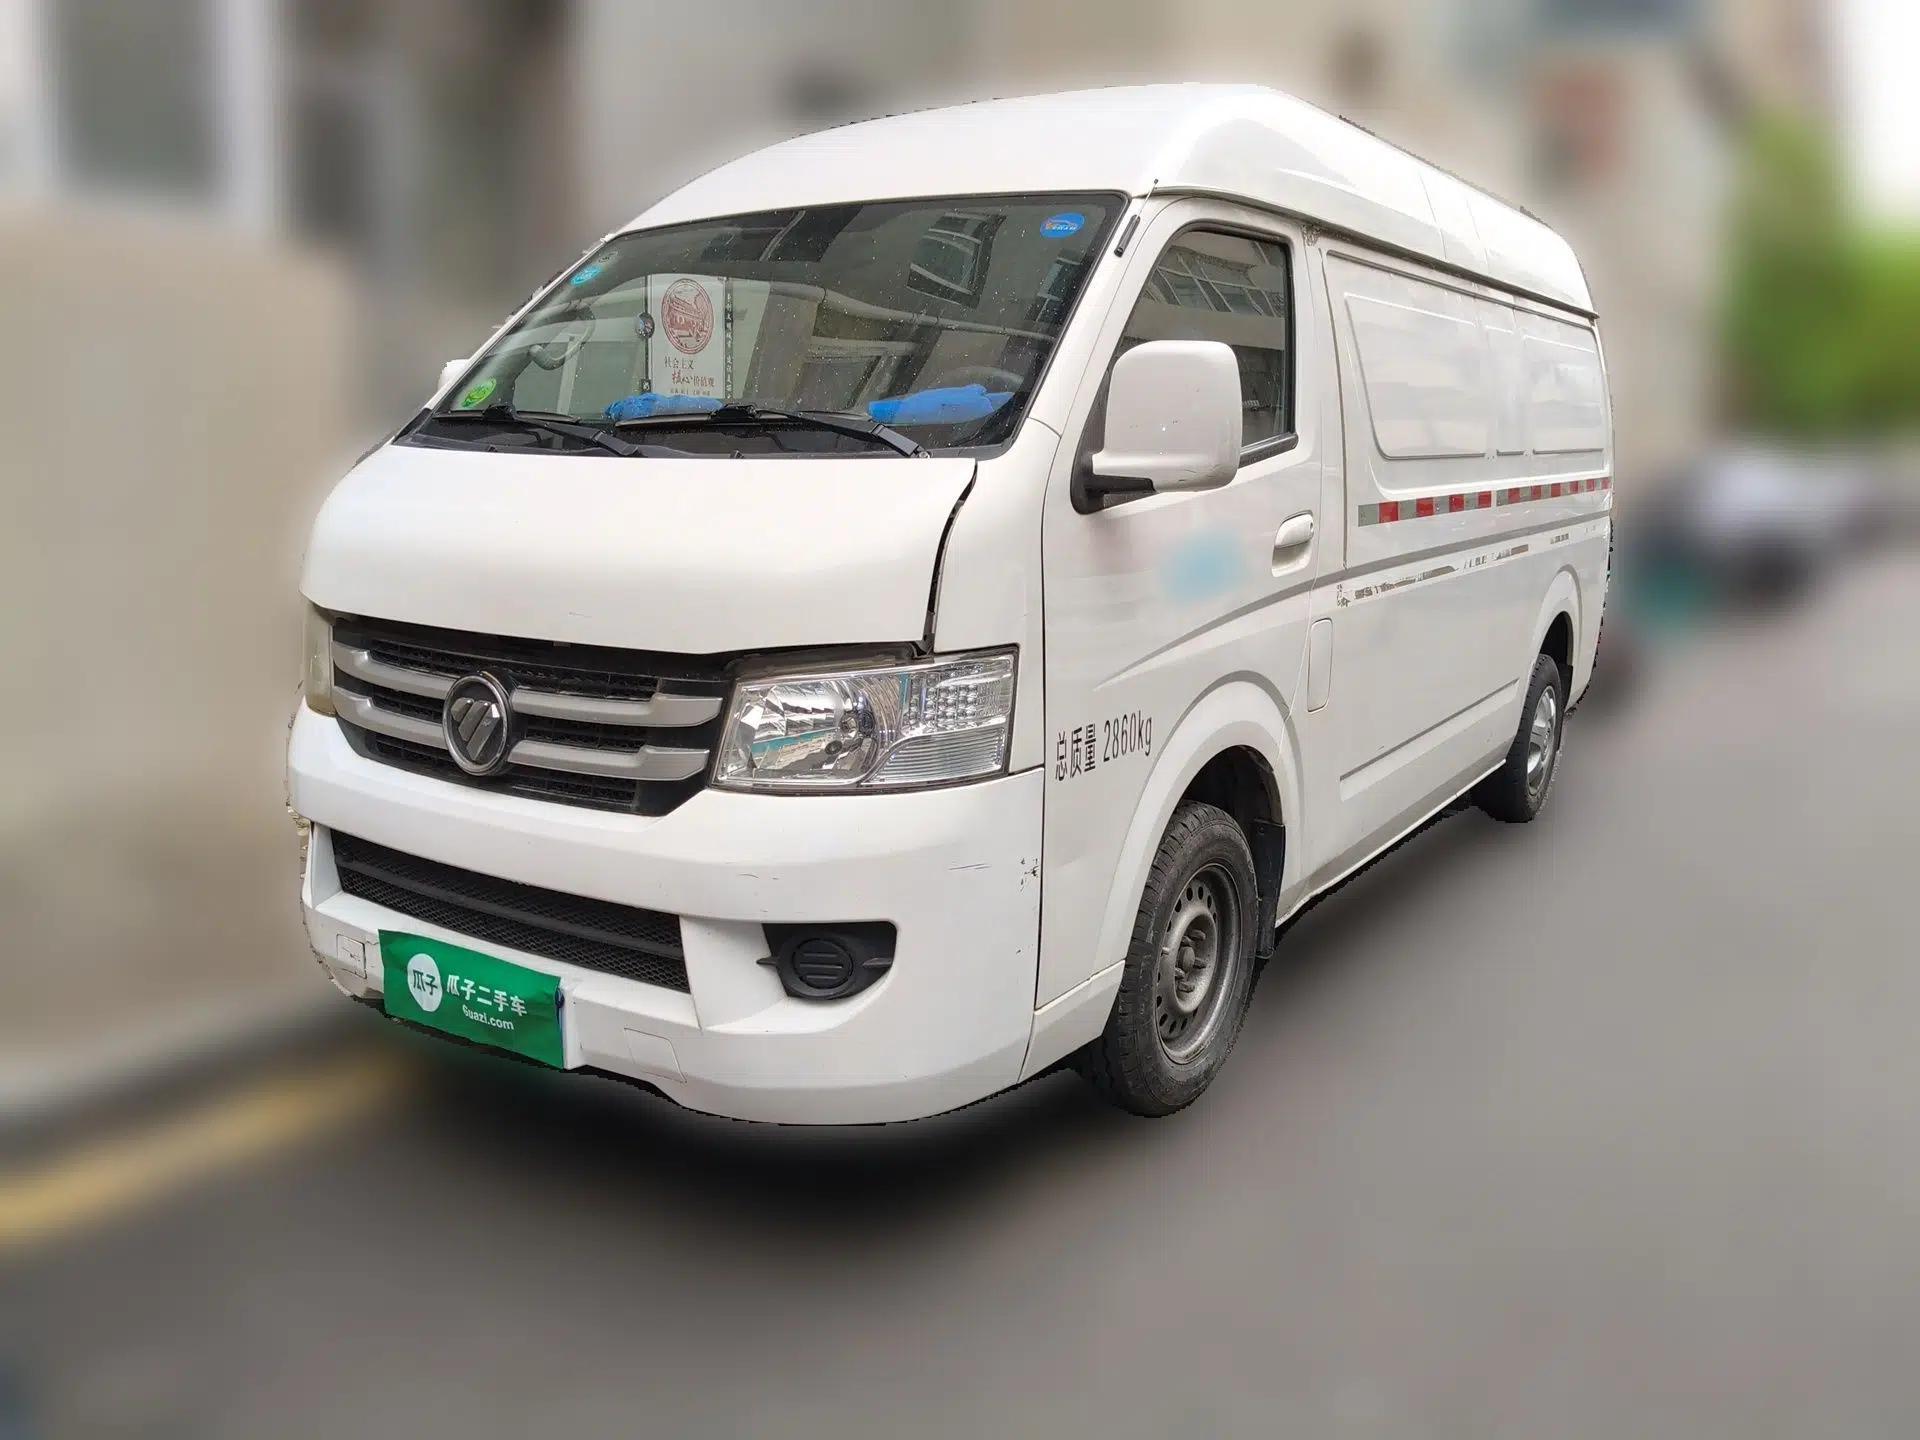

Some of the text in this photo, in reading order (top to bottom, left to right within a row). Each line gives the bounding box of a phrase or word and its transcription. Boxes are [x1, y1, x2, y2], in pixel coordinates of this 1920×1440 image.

[664, 355, 695, 370] 社会主义
[1055, 709, 1152, 781] 总质量 2860kg
[412, 968, 438, 996] 瓜子
[446, 974, 528, 1017] 瓜子二手车
[462, 1004, 515, 1031] Guazi.com
